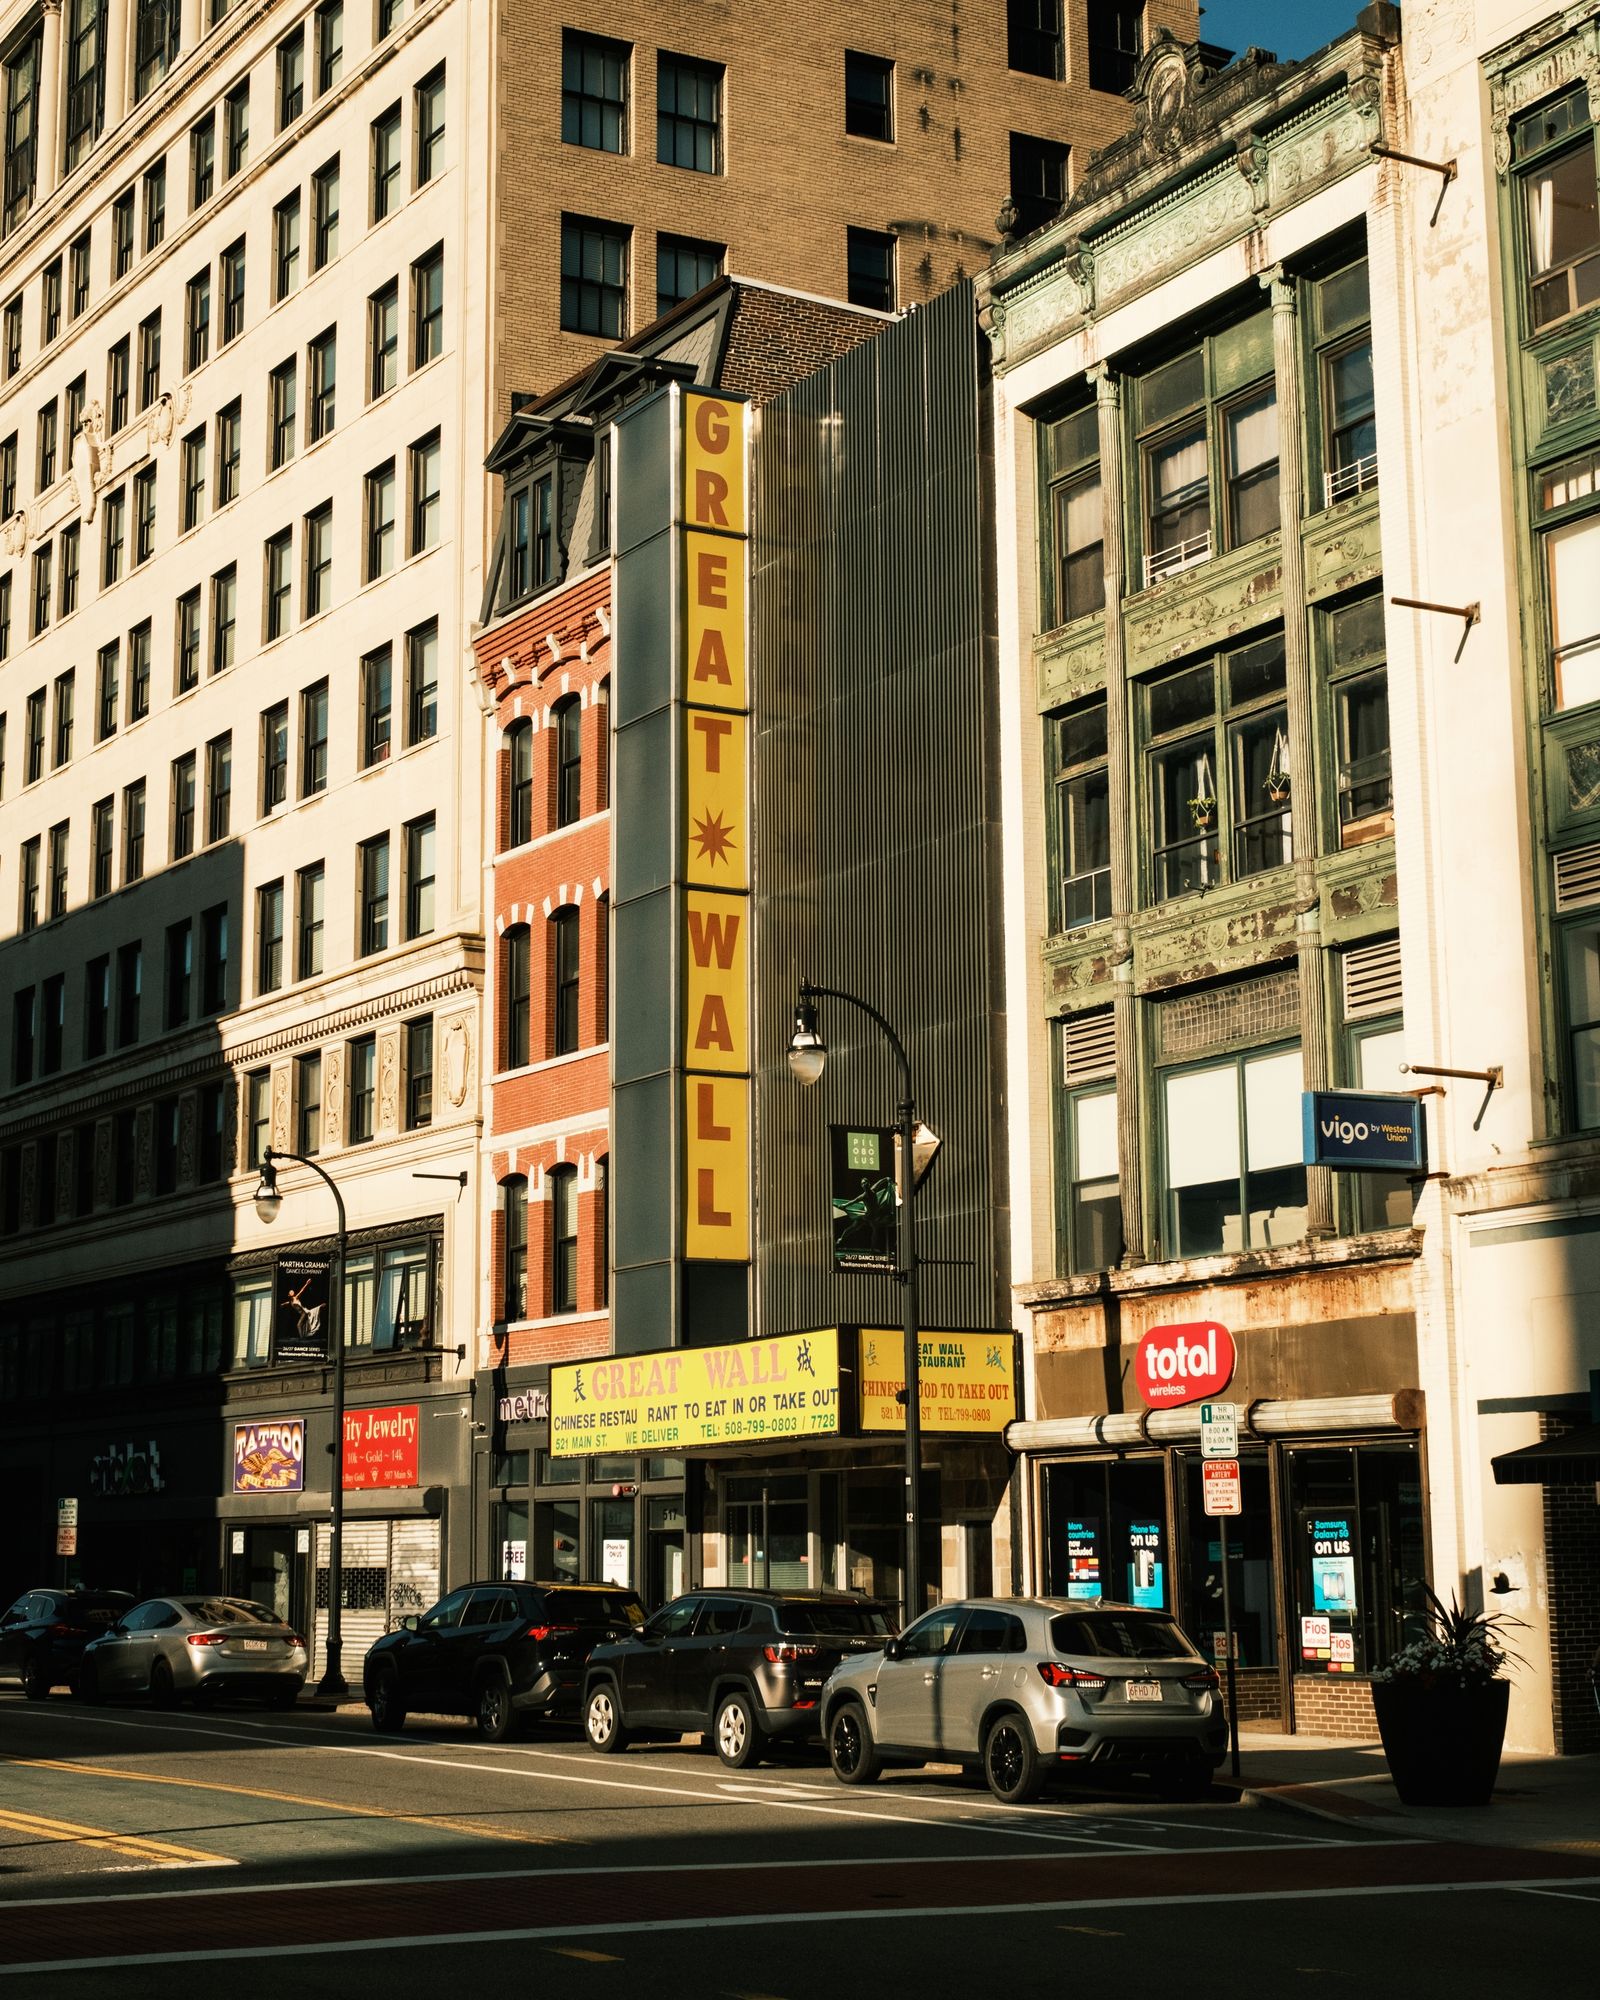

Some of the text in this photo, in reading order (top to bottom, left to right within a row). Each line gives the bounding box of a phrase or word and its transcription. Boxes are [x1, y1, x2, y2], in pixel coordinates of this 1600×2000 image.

[694, 399, 733, 774] GREAT
[687, 910, 740, 1228] WALL
[1321, 1115, 1412, 1144] vigo by Western
[1386, 1134, 1408, 1142] Union
[304, 1261, 329, 1269] GRAHAM
[917, 1343, 965, 1355] EAT WALL
[1145, 1329, 1217, 1380] total
[917, 1356, 967, 1368] STAURANT
[592, 1342, 788, 1402] GREAT WALL
[941, 1383, 955, 1399] TO
[957, 1383, 986, 1400] TAKE
[988, 1384, 1010, 1400] OUT
[1149, 1383, 1186, 1397] wireless
[554, 1387, 839, 1431] CHINESE RESTAU RANT TO EAT IN OR TAKE OUT
[881, 1406, 893, 1419] 521
[921, 1406, 932, 1420] ST
[343, 1412, 416, 1447] ity Jewelry
[556, 1438, 569, 1450] 521
[572, 1435, 592, 1449] MAIN
[595, 1433, 608, 1447] ST.
[625, 1430, 638, 1445] WE
[641, 1427, 679, 1443] DELIVER
[700, 1423, 720, 1438] TEL:
[725, 1416, 797, 1436] 508-799-0803
[810, 1413, 836, 1429] 7728
[236, 1422, 304, 1465] TATTOO
[365, 1450, 383, 1463] Gold
[391, 1449, 403, 1461] 14k
[1205, 1463, 1236, 1471] EMERGENCY
[354, 1472, 366, 1482] Gold
[1211, 1471, 1231, 1479] ARTERY
[663, 1509, 677, 1521] 517
[1067, 1522, 1083, 1531] More
[1315, 1520, 1347, 1530] Samsung
[1067, 1530, 1095, 1539] countries
[1130, 1534, 1159, 1547] on us
[1314, 1529, 1349, 1541] Galaxy 5G
[1068, 1547, 1093, 1556] included
[1315, 1540, 1351, 1555] on us
[504, 1551, 525, 1564] FREE
[1305, 1621, 1328, 1635] Fios
